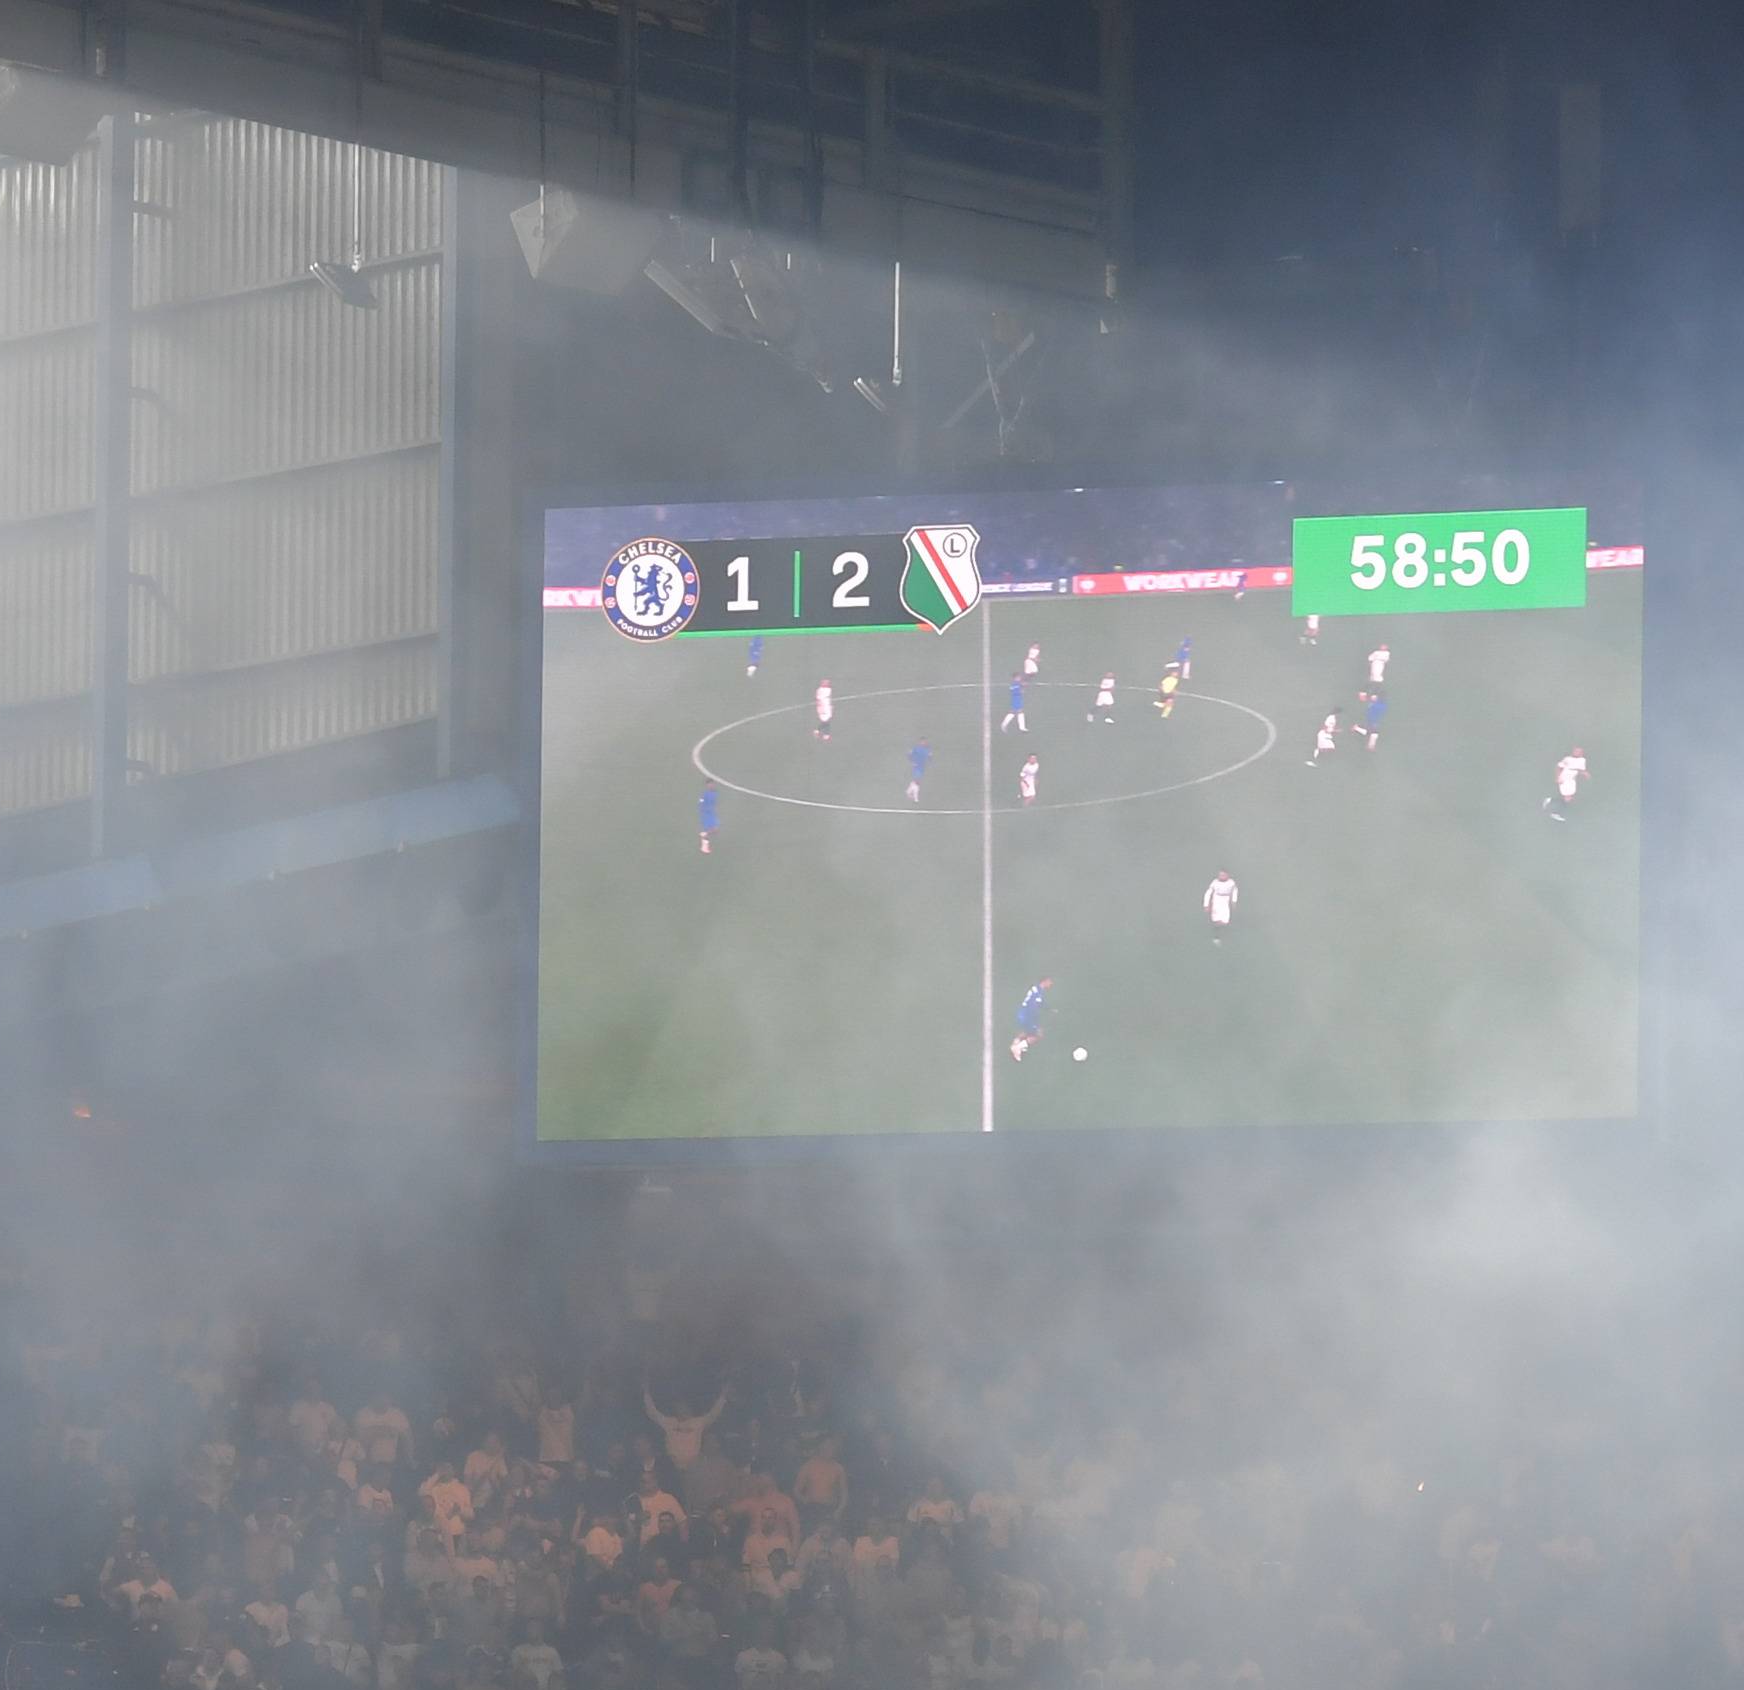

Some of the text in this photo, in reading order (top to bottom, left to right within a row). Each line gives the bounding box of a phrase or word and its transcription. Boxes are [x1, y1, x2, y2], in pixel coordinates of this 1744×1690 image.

[618, 541, 682, 564] CHELSEA
[832, 551, 870, 608] 2
[1349, 528, 1531, 591] 58:50
[726, 556, 759, 612] 1
[616, 615, 683, 638] FOOTBALL CLUB
